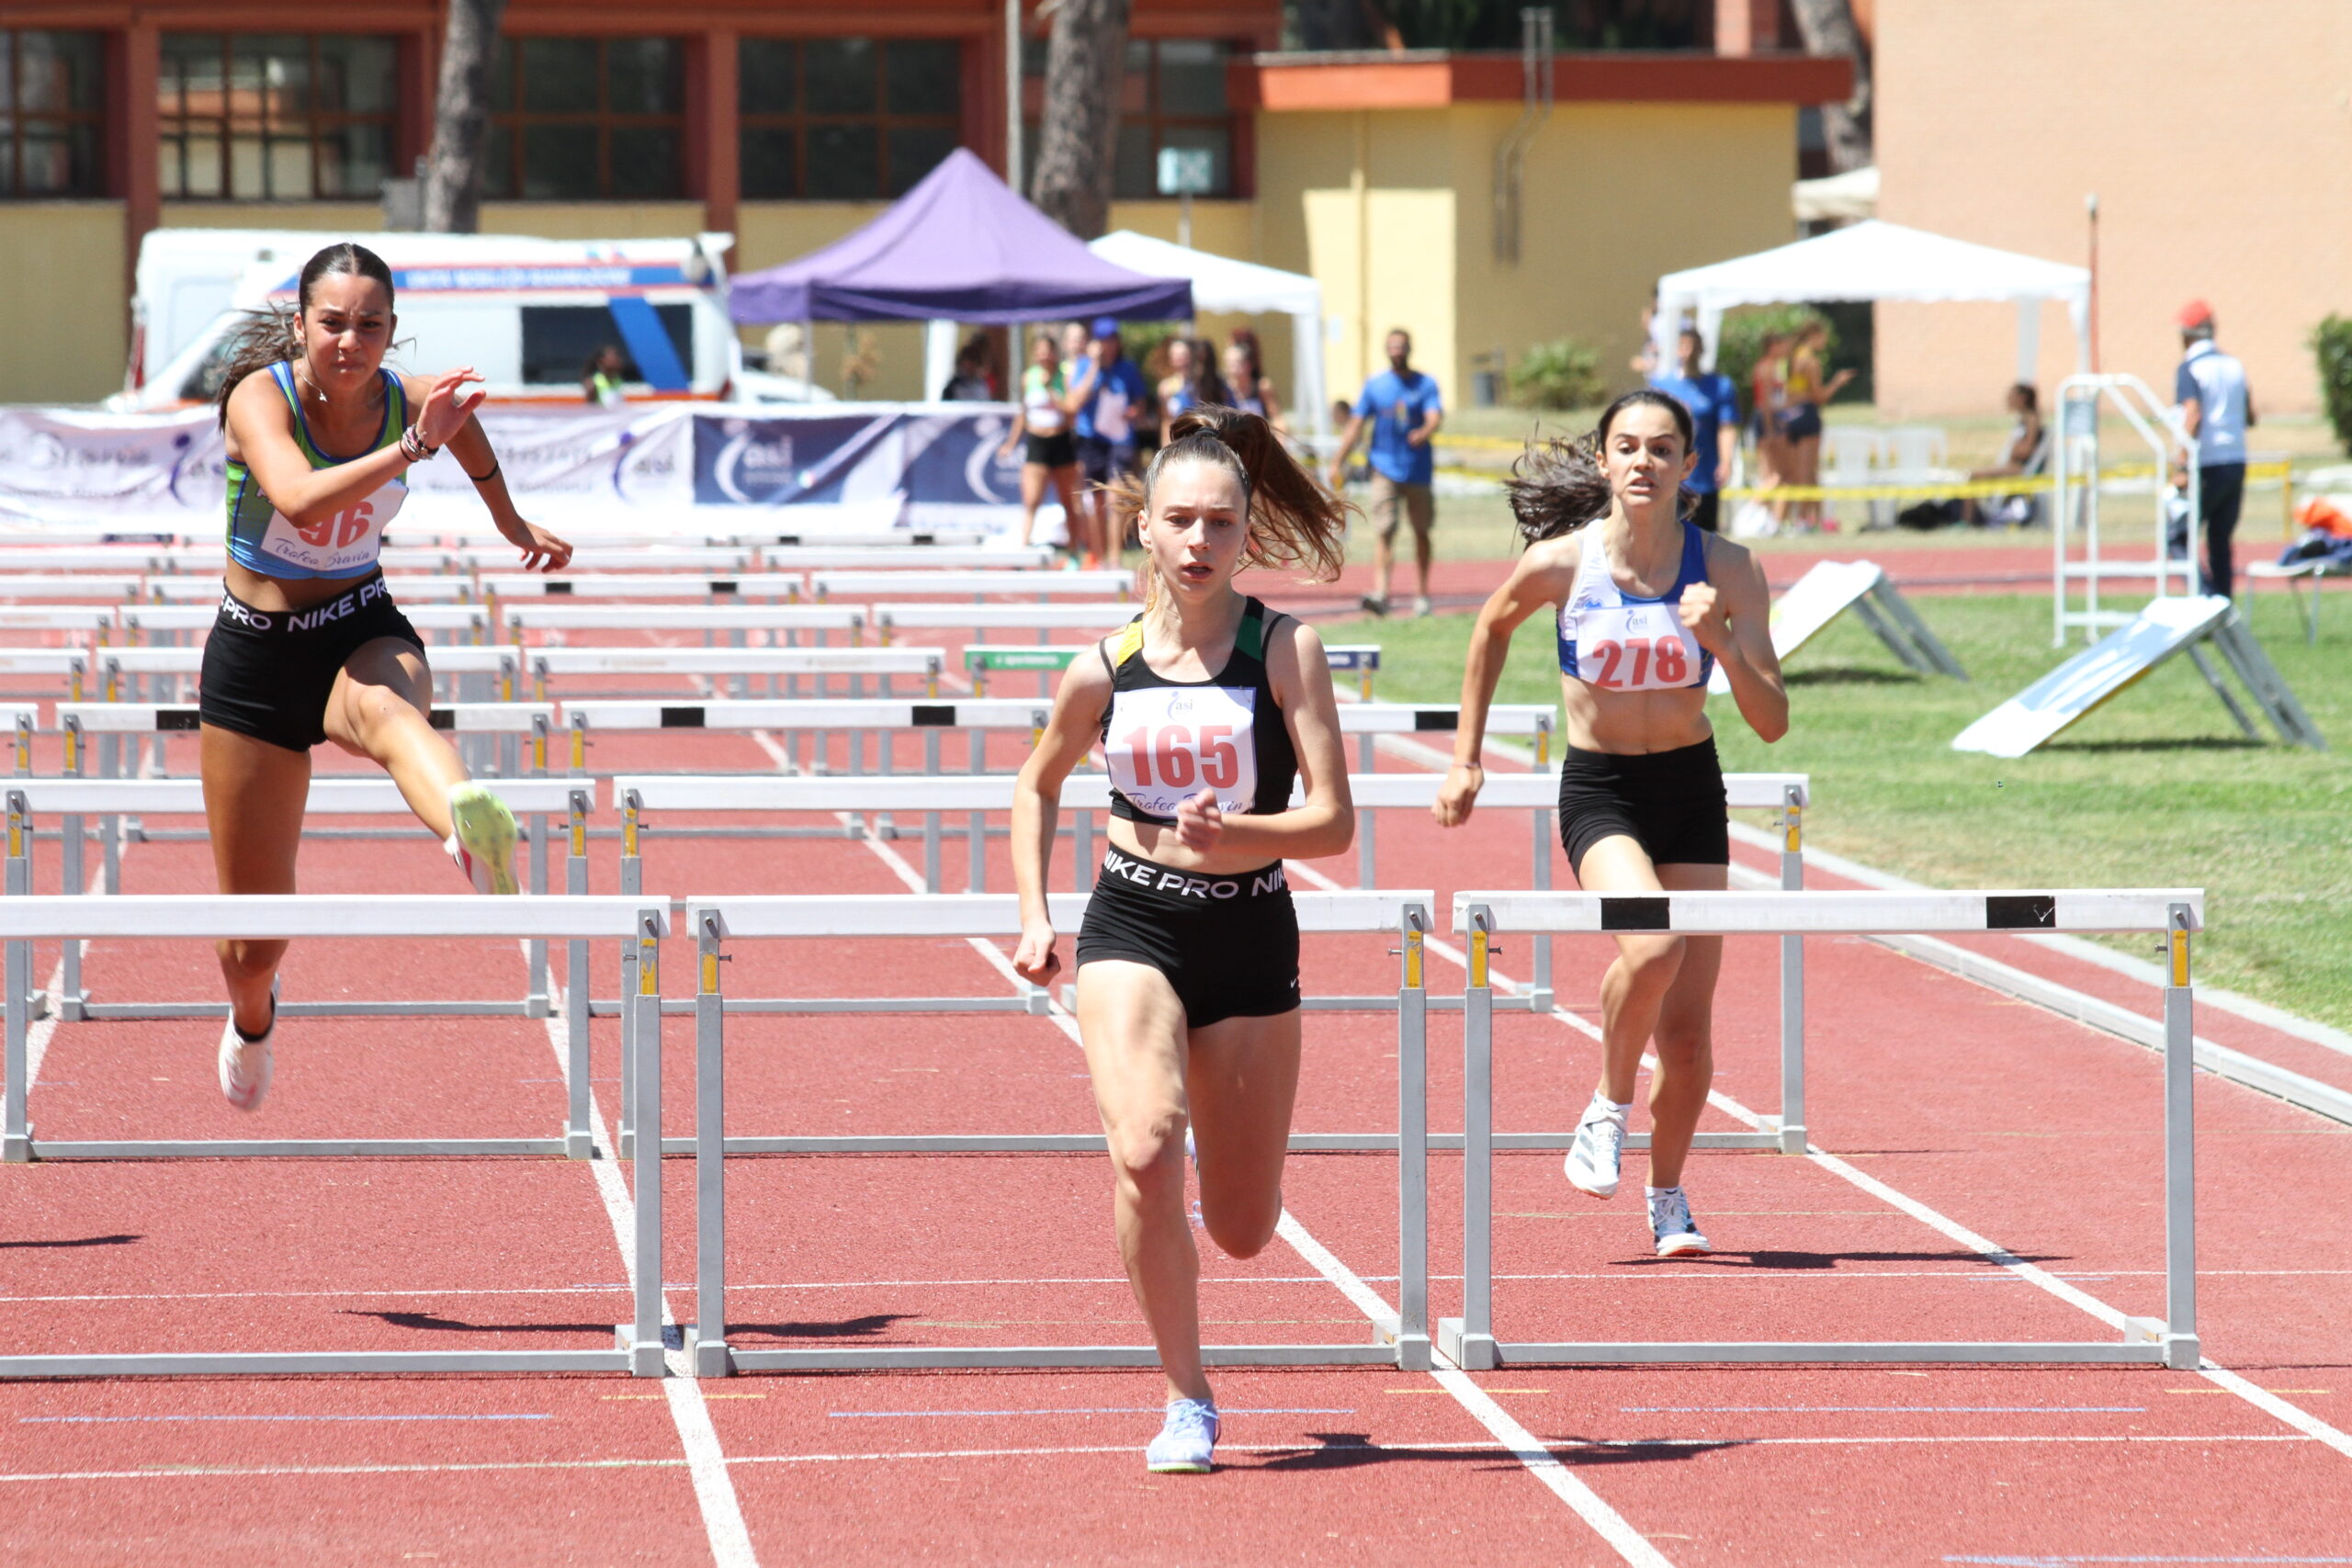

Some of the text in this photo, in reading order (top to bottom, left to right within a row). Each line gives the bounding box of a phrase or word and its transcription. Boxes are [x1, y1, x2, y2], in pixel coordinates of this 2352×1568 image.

[222, 595, 273, 630] PRO
[287, 592, 356, 633] NIKE
[1592, 635, 1687, 688] 278
[1175, 698, 1193, 710] asi
[1122, 725, 1239, 789] 165
[1102, 849, 1158, 886] NIKE
[1156, 873, 1239, 899] PRO
